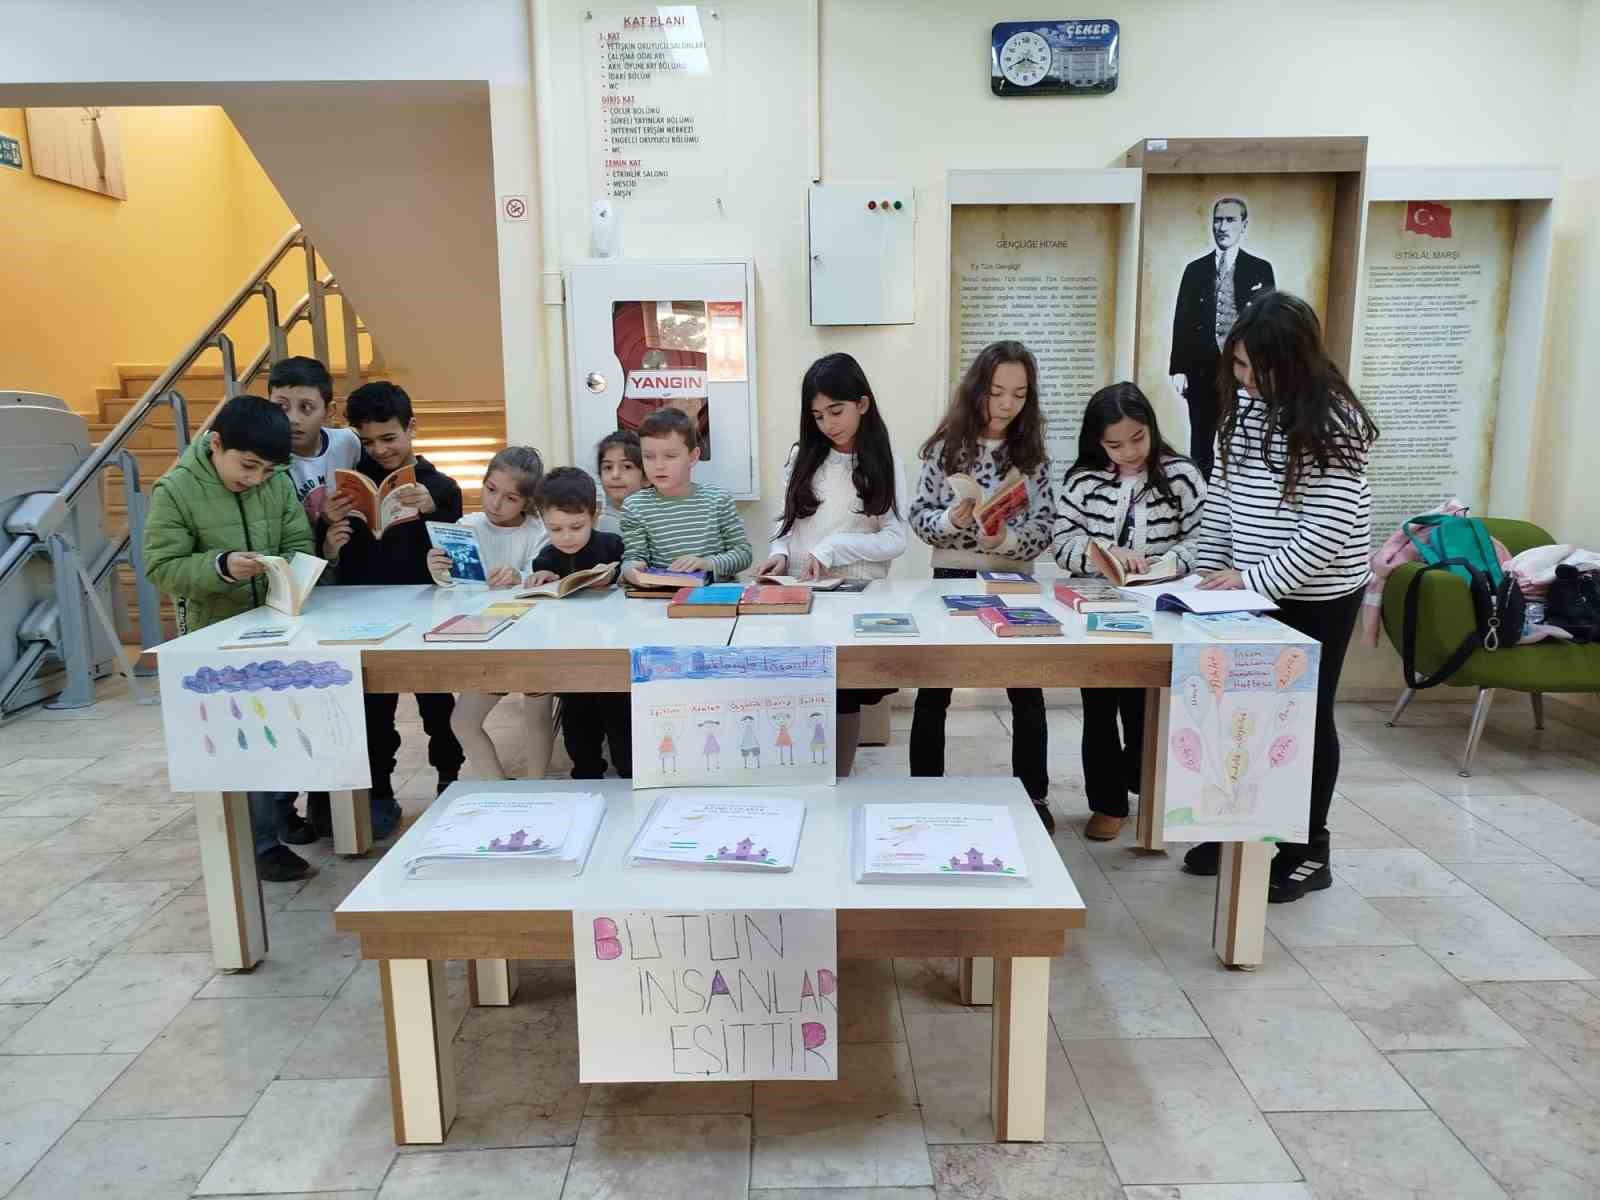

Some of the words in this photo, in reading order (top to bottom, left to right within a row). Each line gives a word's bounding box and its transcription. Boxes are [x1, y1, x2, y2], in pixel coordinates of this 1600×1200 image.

[623, 16, 646, 26] KAT
[650, 15, 685, 26] PLANI
[622, 96, 635, 104] KAT
[629, 159, 642, 168] KAT
[631, 376, 703, 389] YANGIN
[593, 911, 784, 961] BÜTÜN
[670, 1017, 831, 1075] EŞİTTİR
